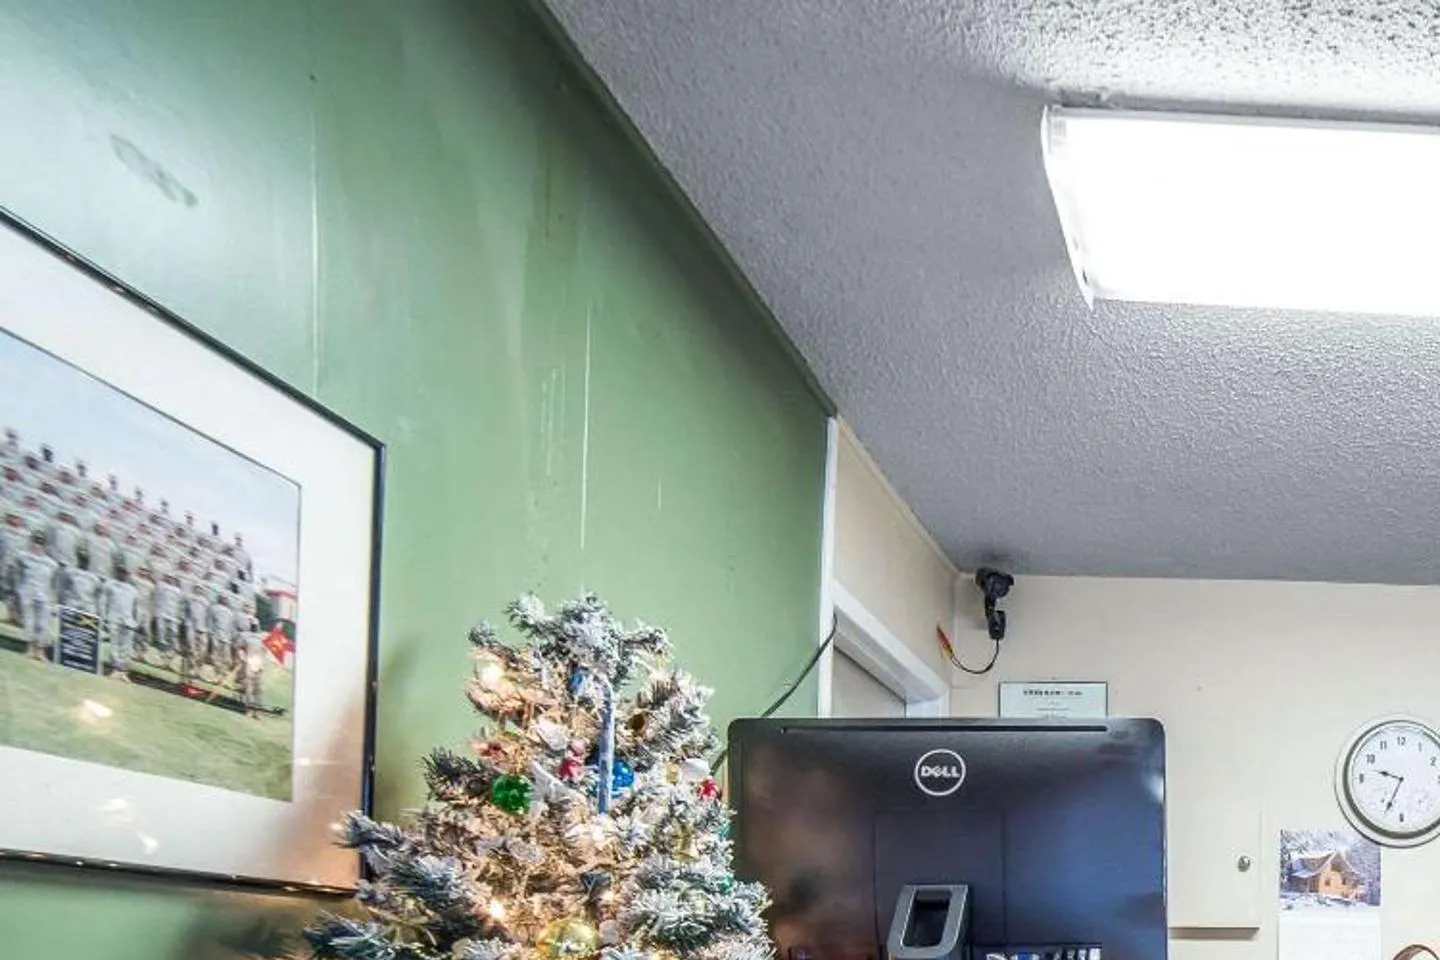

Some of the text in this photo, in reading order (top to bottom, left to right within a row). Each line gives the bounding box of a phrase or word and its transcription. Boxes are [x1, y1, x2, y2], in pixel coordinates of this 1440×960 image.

[1380, 740, 1387, 750] 11
[1397, 737, 1406, 746] 12
[921, 765, 961, 778] DELL
